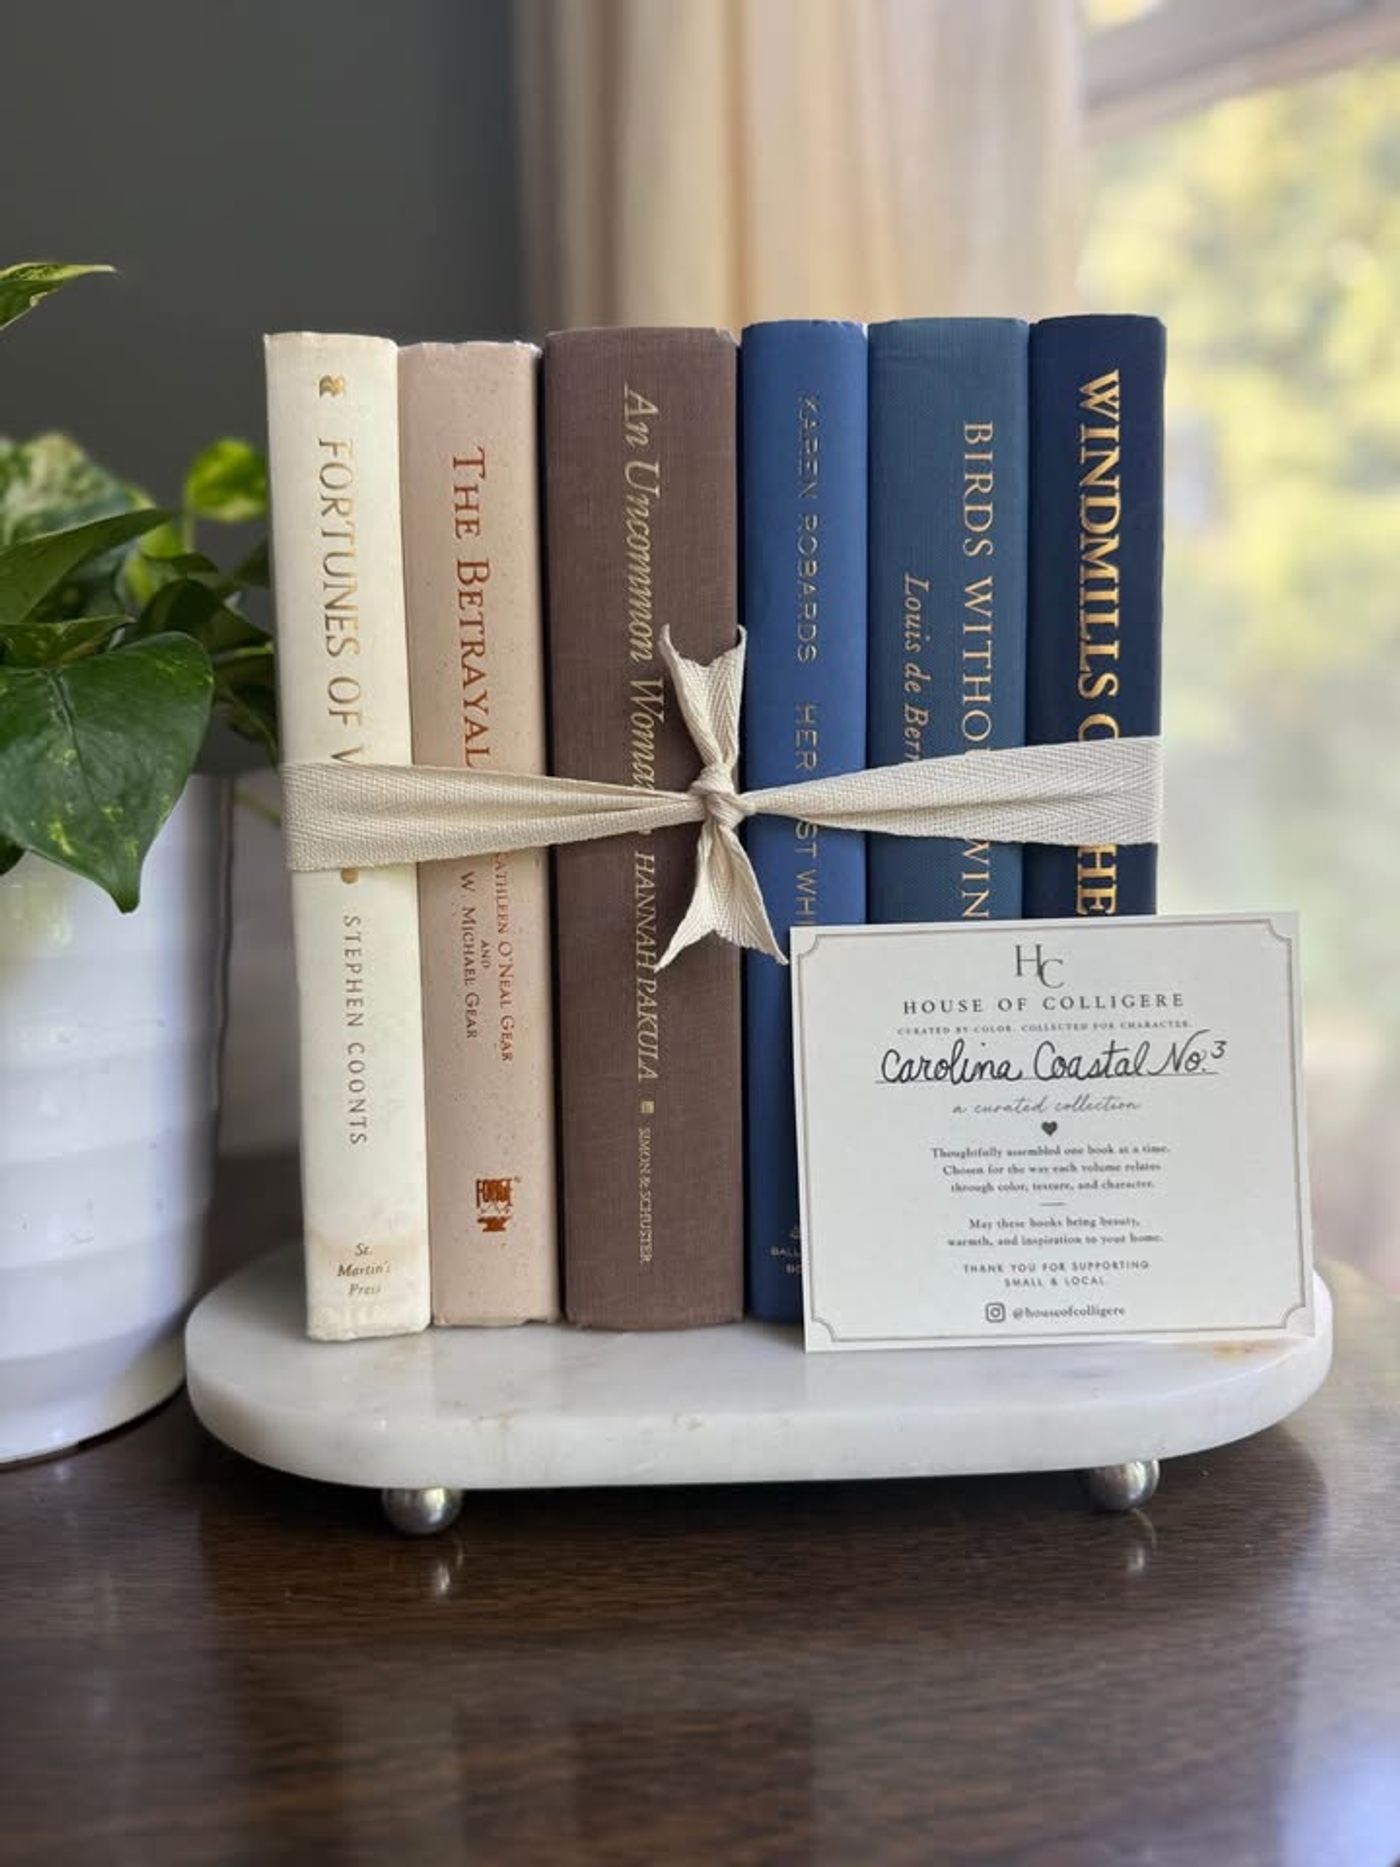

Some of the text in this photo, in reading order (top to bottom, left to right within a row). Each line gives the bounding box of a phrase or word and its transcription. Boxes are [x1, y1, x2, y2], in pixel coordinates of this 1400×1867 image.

[624, 382, 659, 449] An
[318, 437, 361, 658] FORTUNES
[796, 396, 820, 663] KAREN ROBARDS
[1078, 368, 1121, 699] WINDMILLS
[625, 460, 661, 663] Uncommon
[452, 446, 491, 768] THE BETRAYAL
[904, 572, 932, 653] Louis
[904, 662, 931, 694] de
[961, 421, 994, 920] BIRDS WITHO WIN
[327, 675, 363, 728] OF
[794, 703, 818, 771] HER
[795, 820, 818, 859] ST
[1076, 843, 1118, 915] HE
[461, 906, 477, 987] MICHAEL
[480, 939, 491, 969] AND
[634, 851, 660, 1084] HANNAH PAKULA
[1015, 944, 1065, 989] HC
[498, 941, 514, 1009] O'NEAL
[464, 991, 480, 1040] GEAR
[903, 993, 1185, 1015] HOUSE OF COLLIGERE
[343, 914, 367, 1145] STEPHEN COONTS
[500, 1015, 515, 1063] GEAR
[897, 1026, 950, 1036] CURATED
[956, 1026, 968, 1034] BY
[1021, 1023, 1089, 1033] COLLECTED
[1093, 1022, 1115, 1031] FOR
[880, 1038, 1023, 1084] Carolina
[1033, 1039, 1151, 1082] Coastal
[952, 1094, 1141, 1115] a curated collection
[930, 1143, 1171, 1160] Thoughtfully assembled one book at a time.
[943, 1159, 1161, 1176] Chosen for the way each volume relates
[638, 1127, 653, 1264] SIMON & SCHUSTER
[951, 1178, 1155, 1194] through color, texture, and character.
[947, 1231, 1164, 1247] warmth, and inspiration to your home.
[969, 1218, 993, 1230] May
[996, 1217, 1026, 1229] these
[1029, 1217, 1063, 1228] books
[1099, 1215, 1141, 1227] beauty,
[336, 1260, 391, 1278] Martin's
[354, 1242, 373, 1257] St.
[963, 1259, 1150, 1274] THANK YOU FOR SUPPORTING
[347, 1283, 382, 1297] Press
[1003, 1275, 1106, 1288] SMALL & LOCAL
[1012, 1303, 1126, 1319] @houseofcolligere
